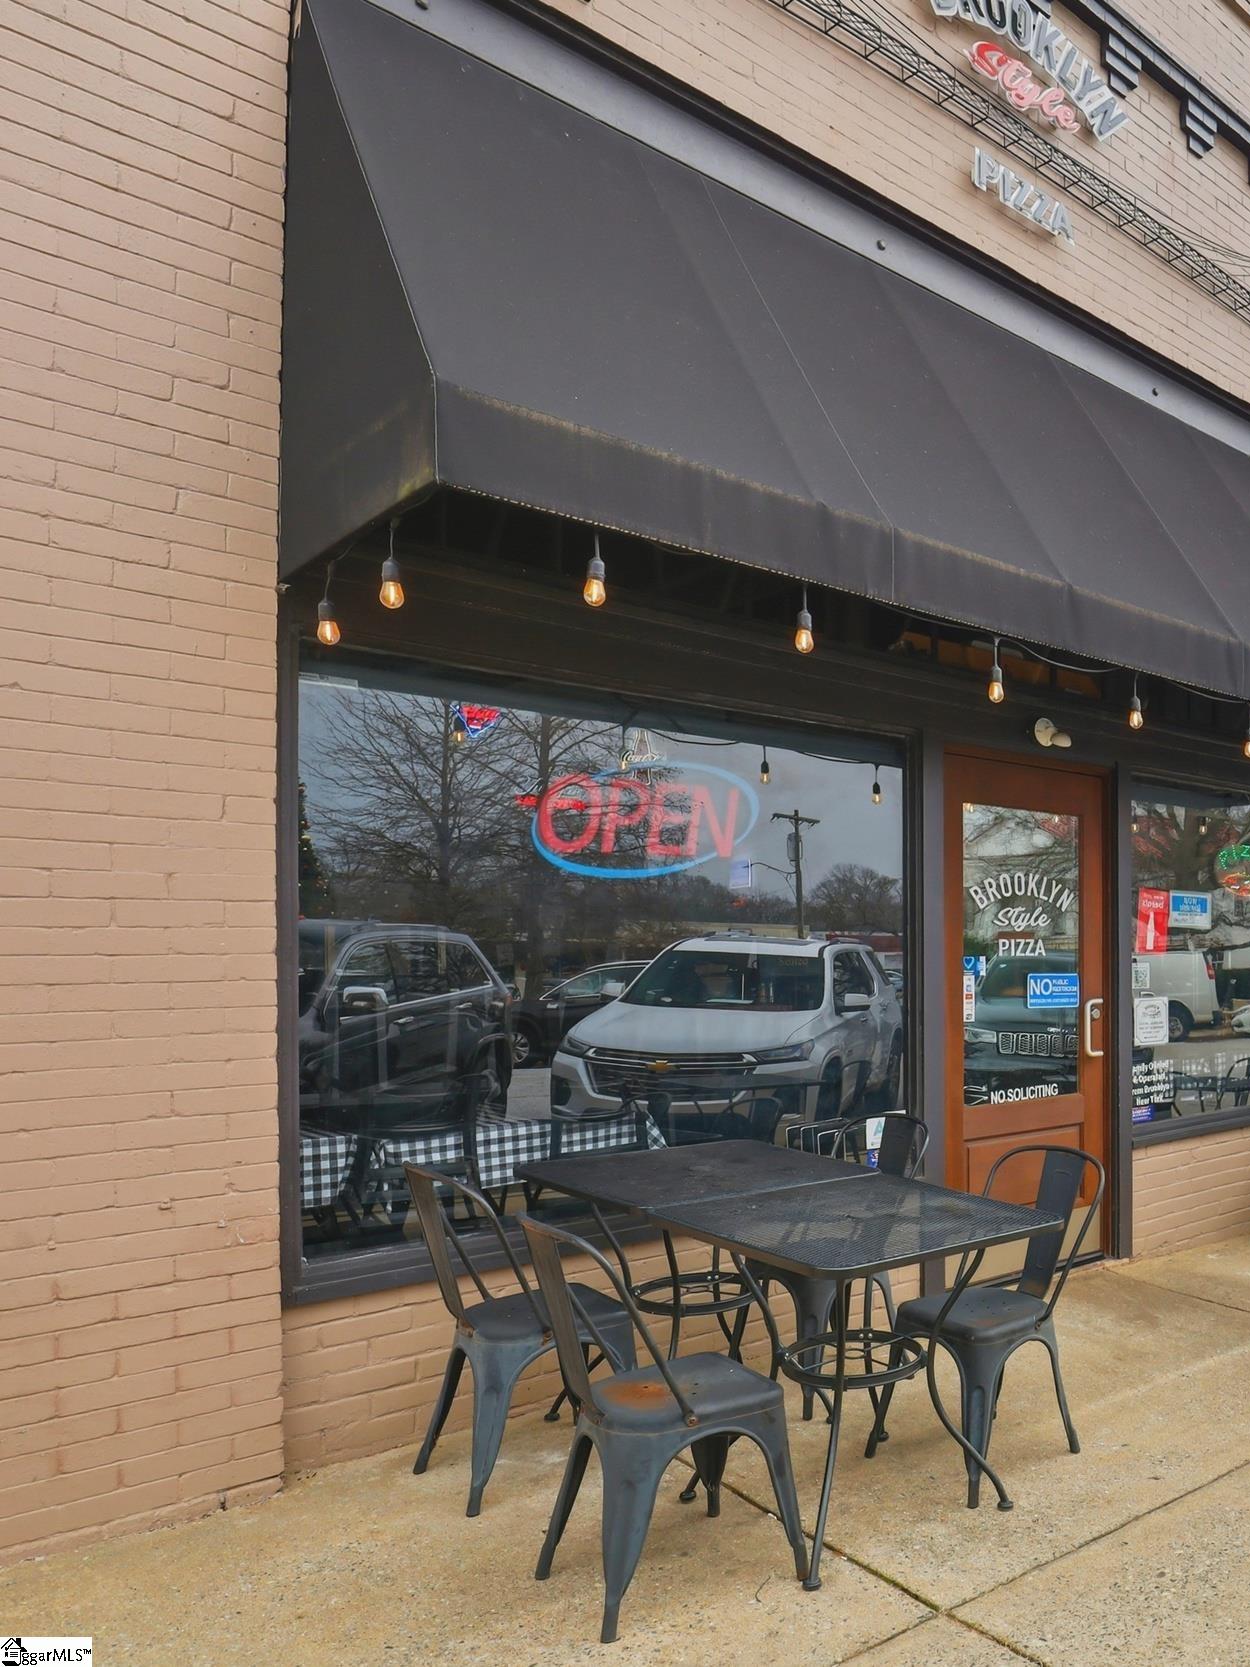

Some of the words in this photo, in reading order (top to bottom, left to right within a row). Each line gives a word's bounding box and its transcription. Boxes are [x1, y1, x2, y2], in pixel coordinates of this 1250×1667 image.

[963, 41, 1081, 134] Style
[971, 146, 1075, 246] PIZZA
[537, 773, 741, 859] OPEN
[969, 872, 1076, 913] BROOKLYN
[993, 906, 1051, 932] Style
[998, 938, 1046, 957] PIZZA
[1030, 978, 1052, 996] NO
[990, 1090, 1006, 1105] NO
[1007, 1083, 1059, 1101] SOLICITING
